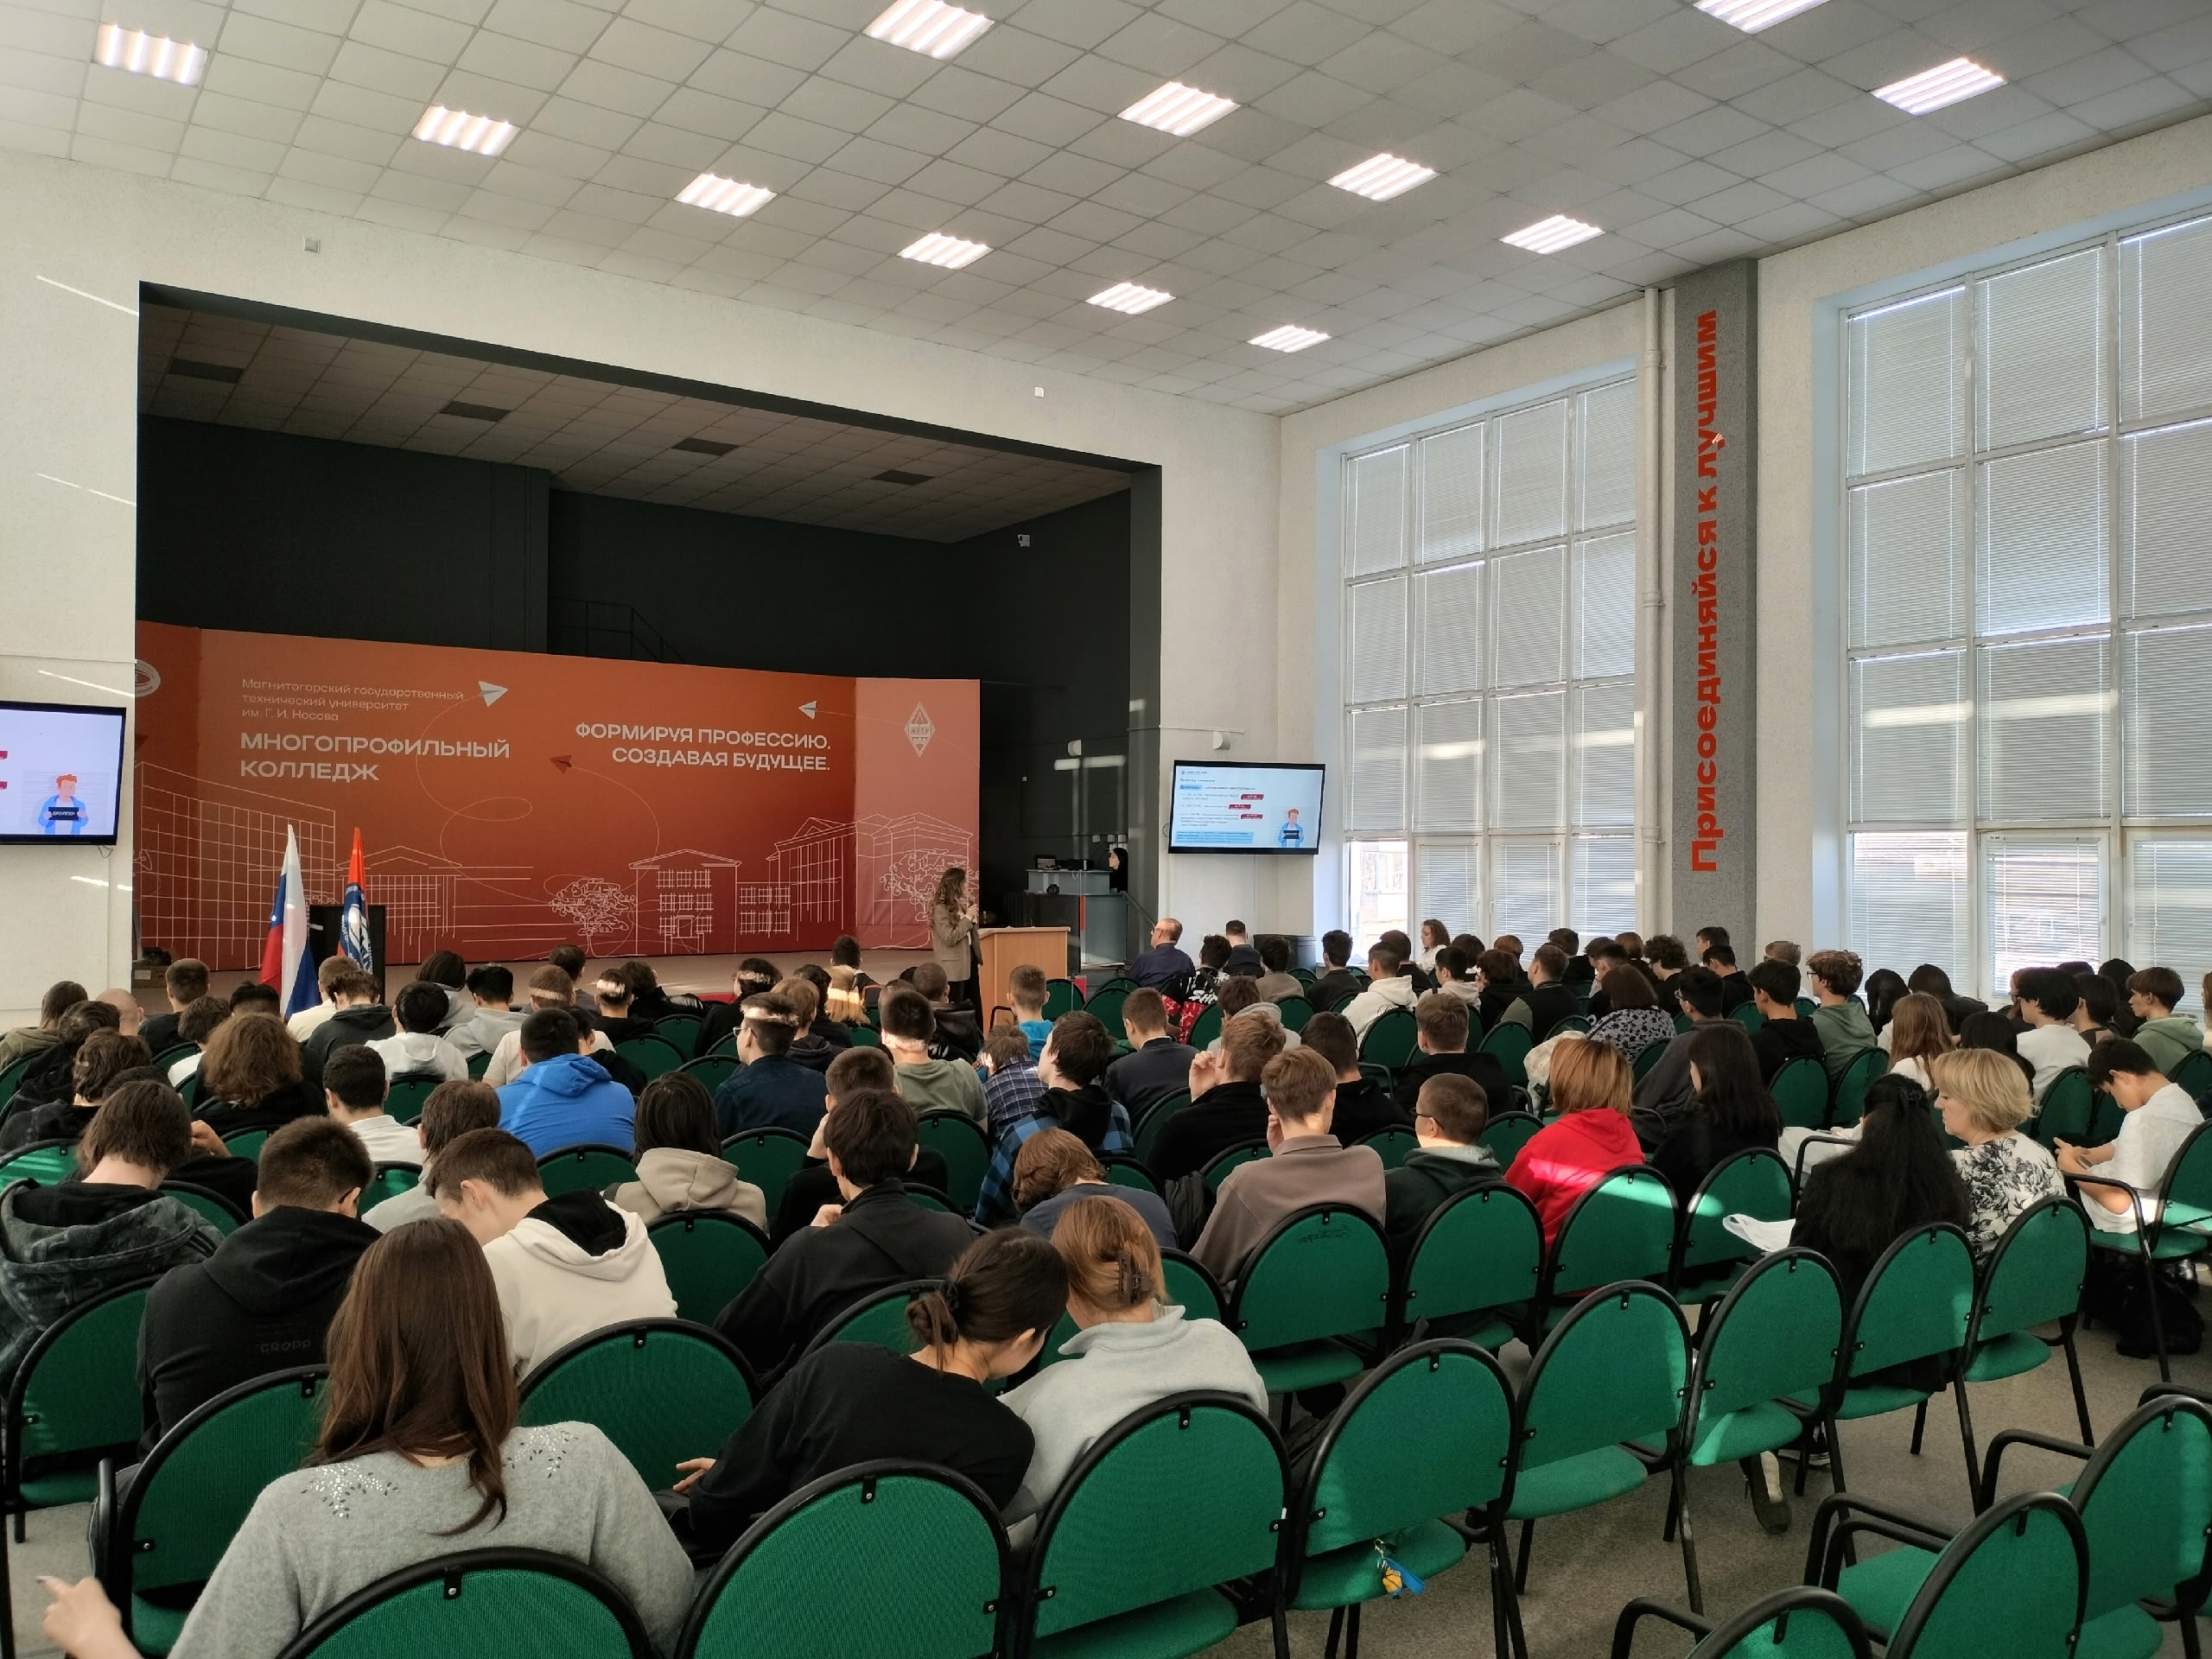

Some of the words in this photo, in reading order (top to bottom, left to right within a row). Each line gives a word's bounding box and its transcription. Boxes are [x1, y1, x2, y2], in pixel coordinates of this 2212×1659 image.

[1697, 309, 1726, 478] лучшим
[1697, 485, 1717, 512] к
[242, 678, 351, 695] Магнитогорский
[353, 685, 464, 701] государственный
[1692, 520, 1724, 872] Присоединяйся
[242, 695, 327, 707] технический
[328, 700, 409, 712] университет
[242, 709, 262, 718] им.
[265, 709, 275, 718] Г.
[276, 709, 289, 719] И.
[292, 709, 339, 721] Носова
[241, 733, 510, 759] МНОГОПРОФИЛЬНЫЙ
[575, 722, 693, 743] ФОРМИРУЯ
[698, 728, 831, 750] ПРОФЕССИЮ.
[241, 760, 379, 783] КОЛЛЕДЖ
[612, 747, 728, 767] СОЗДАВАЯ
[733, 753, 830, 772] БУДУЩЕЕ.
